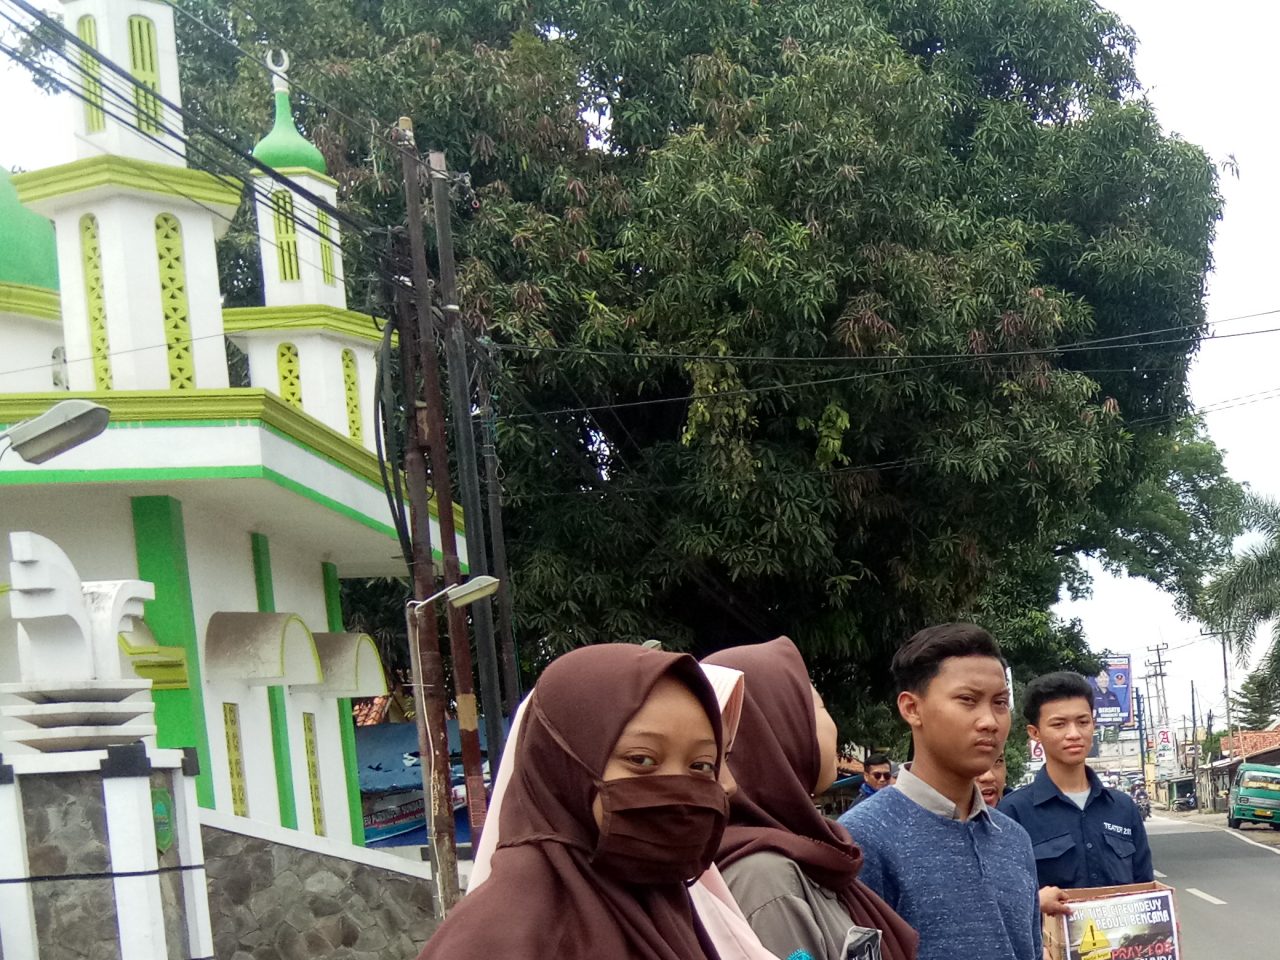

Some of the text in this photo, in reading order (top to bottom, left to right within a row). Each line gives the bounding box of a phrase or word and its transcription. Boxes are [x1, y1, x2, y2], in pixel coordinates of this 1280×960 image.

[1103, 822, 1123, 834] TEATER
[1097, 910, 1170, 930] PEDULI BENCANA
[1112, 940, 1173, 960] PRAY FOR
